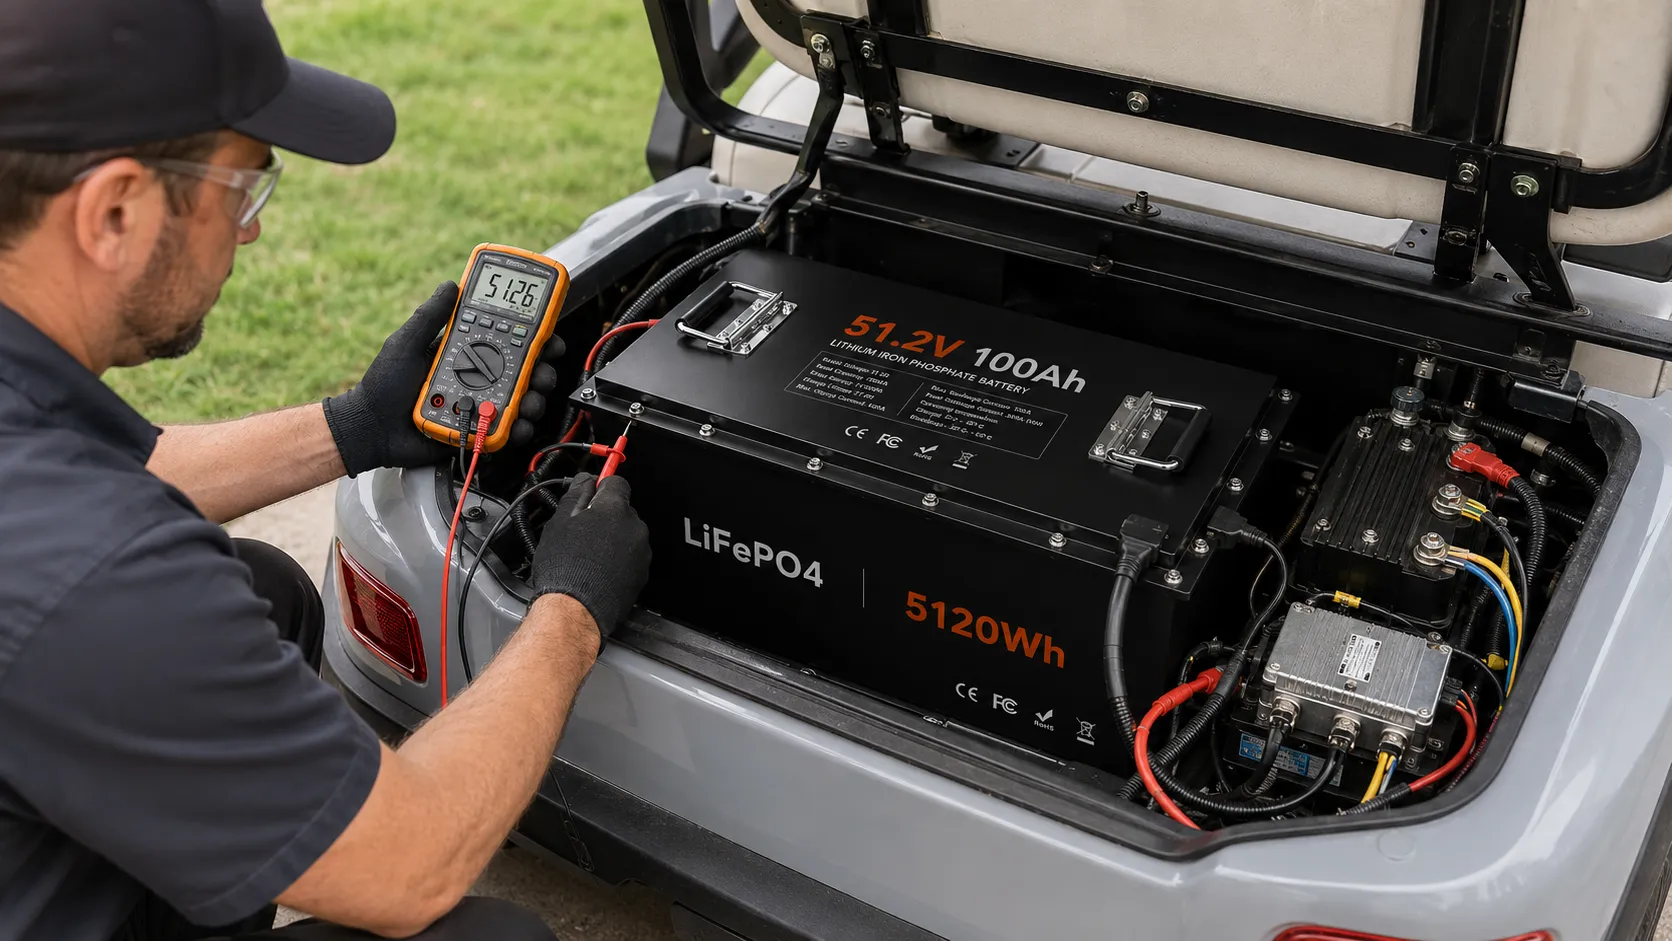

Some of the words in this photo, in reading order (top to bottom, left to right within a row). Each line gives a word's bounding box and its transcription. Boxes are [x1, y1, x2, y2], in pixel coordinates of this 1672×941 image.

[829, 338, 877, 356] LITHIUM
[878, 350, 908, 364] IRON
[908, 358, 977, 382] PHOSPHATE
[978, 376, 1031, 395] BATTERY
[844, 315, 965, 358] 51.2V
[974, 347, 1086, 393] 100Ah
[684, 517, 824, 588] LiFePO4
[905, 591, 1065, 669] 5120Wh
[955, 683, 978, 702] CE
